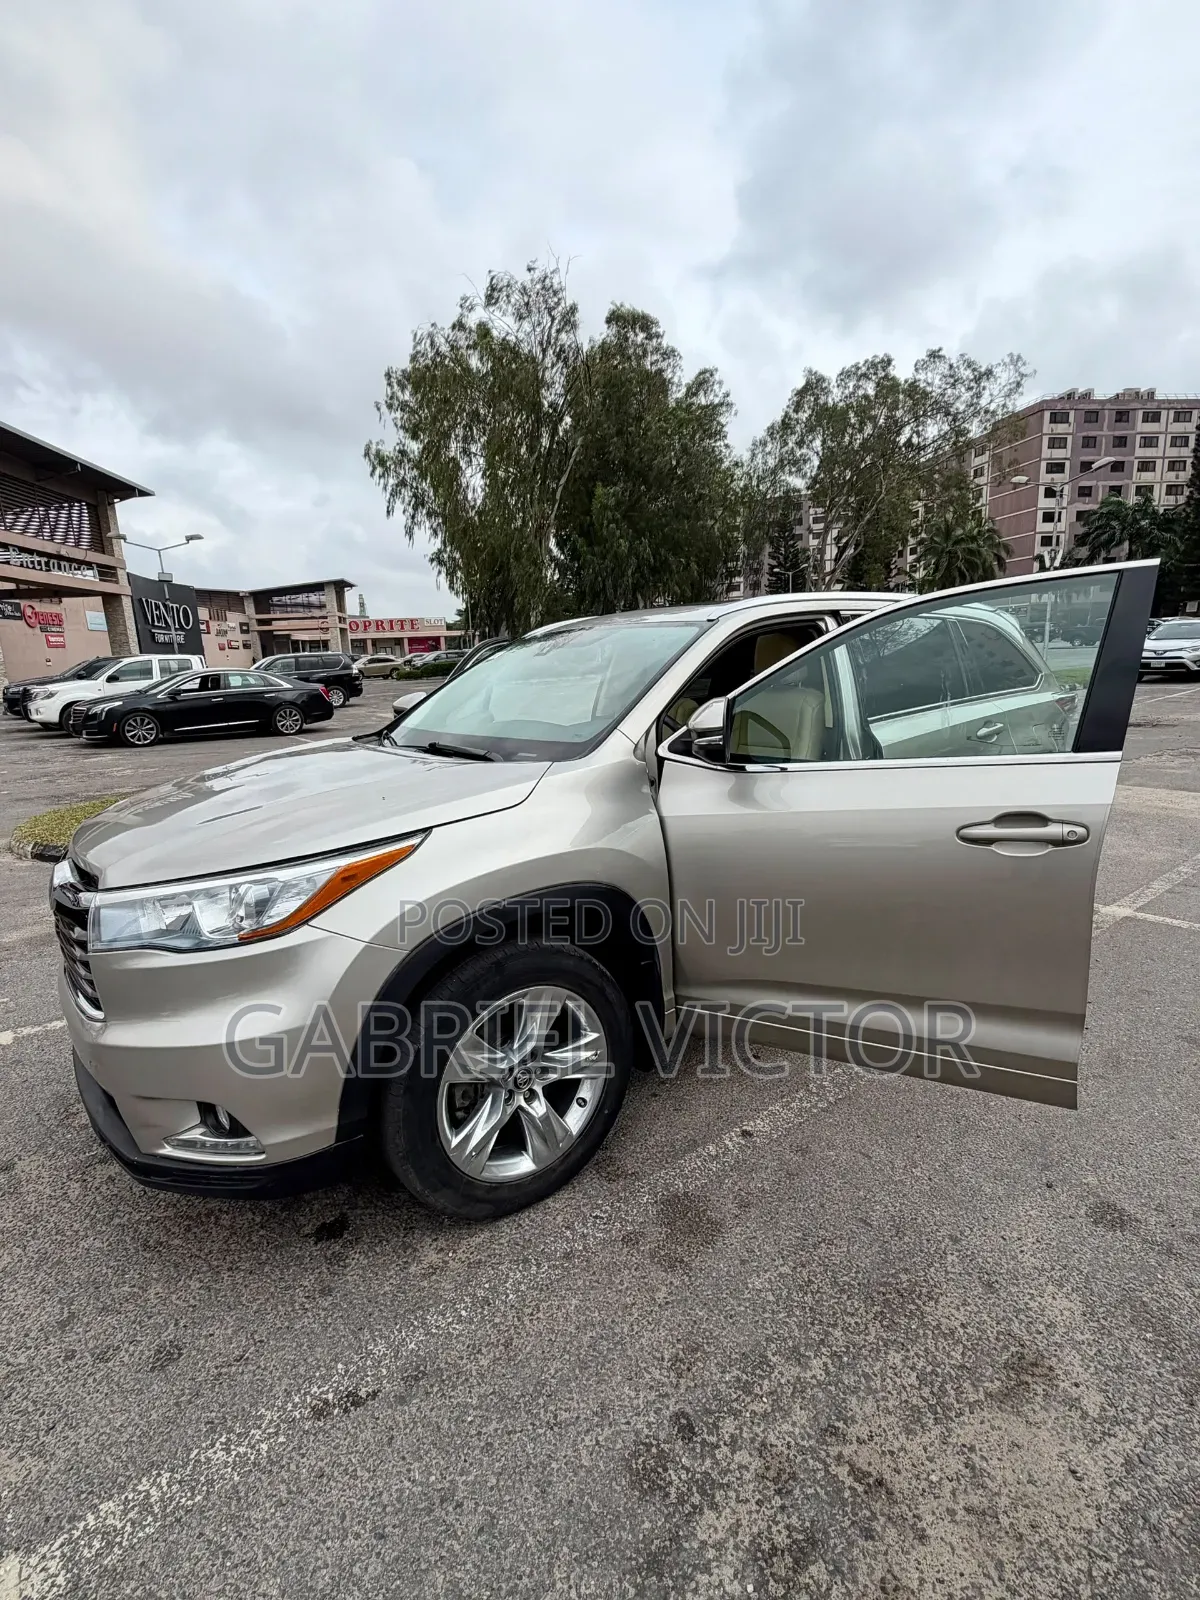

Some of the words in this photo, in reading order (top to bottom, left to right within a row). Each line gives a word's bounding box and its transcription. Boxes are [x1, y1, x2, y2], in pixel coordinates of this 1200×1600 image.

[8, 545, 88, 578] Entrance
[141, 597, 193, 630] VENTO
[425, 617, 444, 626] SLOT
